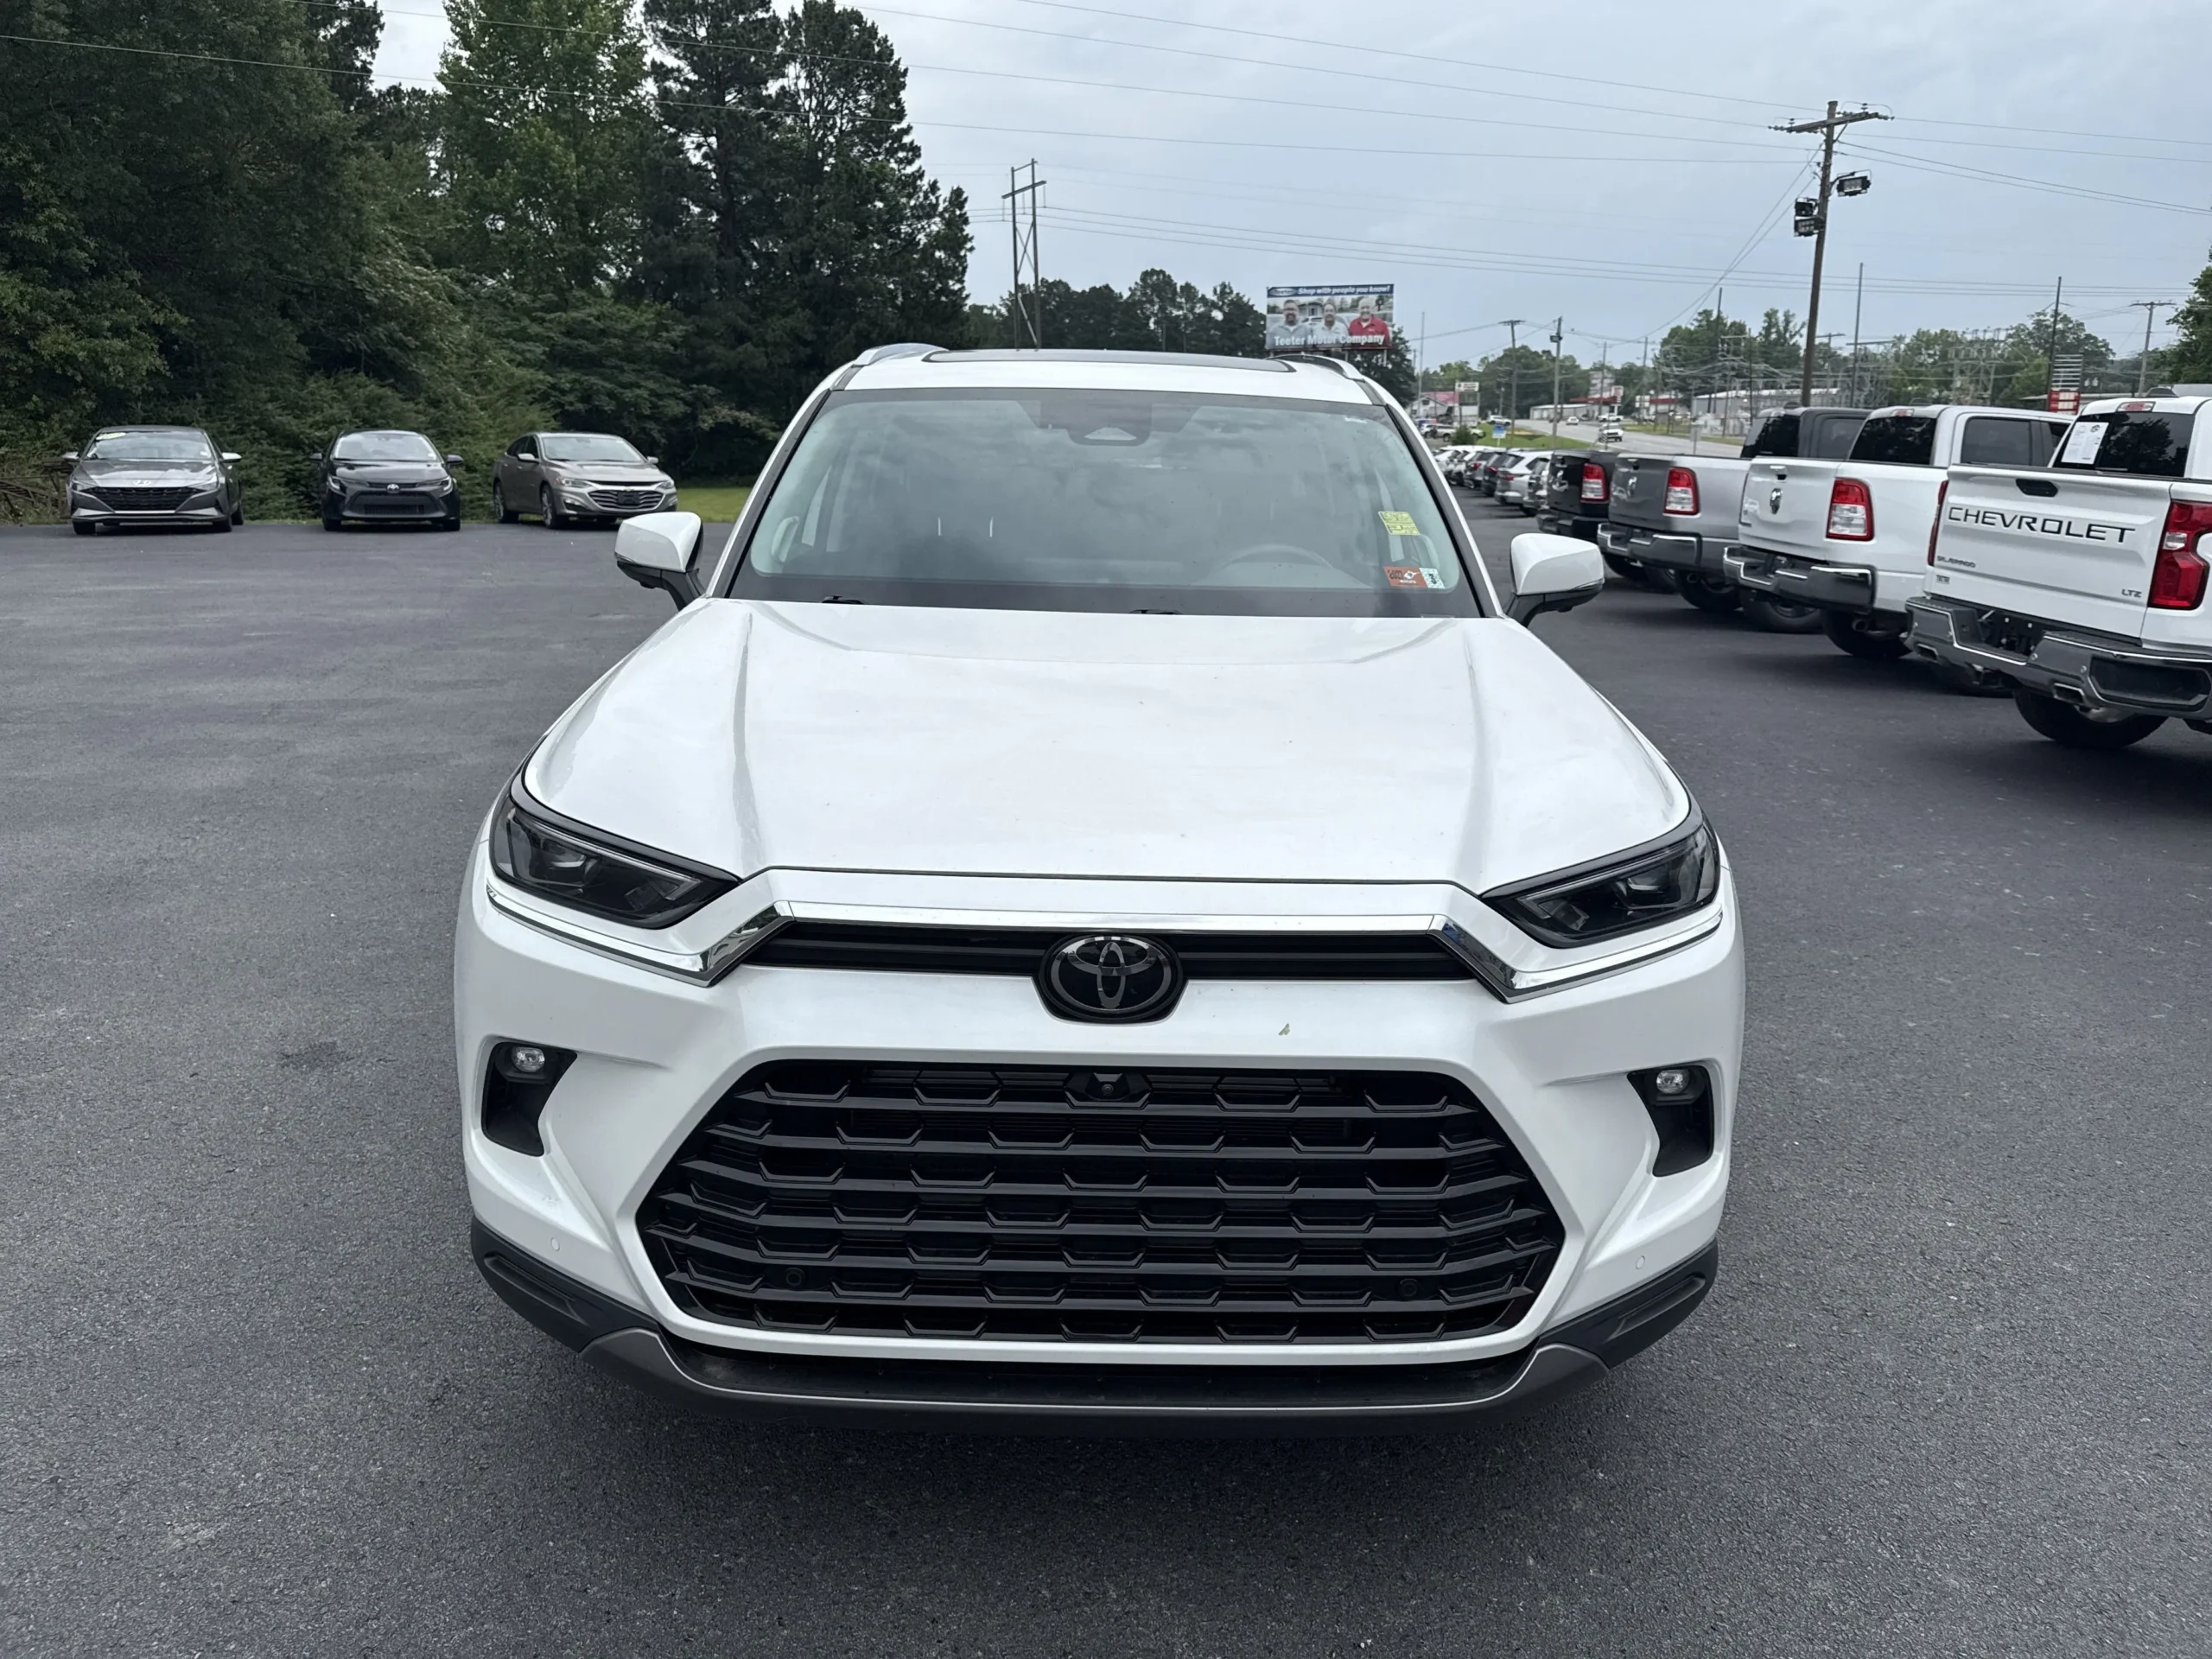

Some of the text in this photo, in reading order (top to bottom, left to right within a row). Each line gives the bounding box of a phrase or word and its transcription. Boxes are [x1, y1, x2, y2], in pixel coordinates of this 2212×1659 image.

[1298, 287, 1315, 296] Shop
[1332, 286, 1355, 295] people
[1274, 334, 1385, 346] Teeter Motor Company
[1948, 506, 2135, 543] CHEVROLET
[2121, 588, 2142, 598] LTZ
